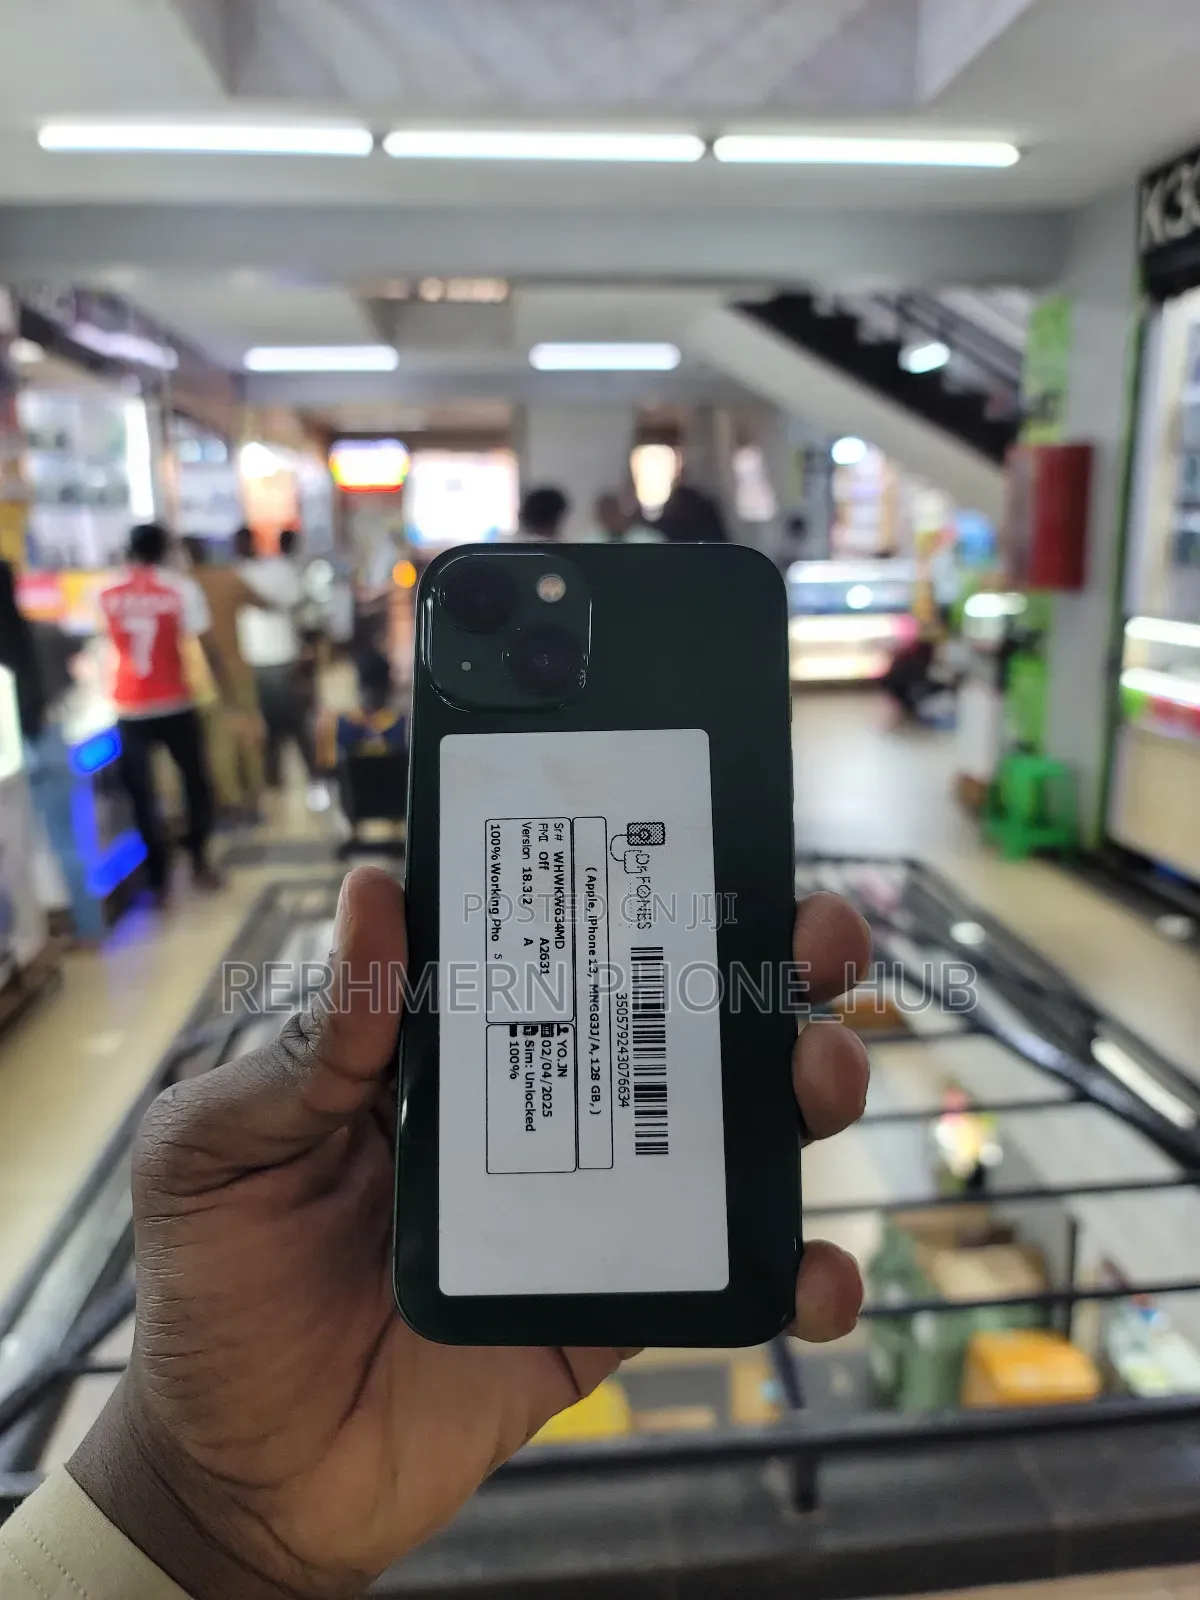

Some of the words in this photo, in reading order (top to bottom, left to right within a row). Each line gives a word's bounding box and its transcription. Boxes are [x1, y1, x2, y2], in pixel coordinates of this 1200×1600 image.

[123, 616, 159, 677] 7
[491, 824, 500, 860] 100%
[522, 822, 532, 859] Version
[539, 823, 548, 842] FMI
[554, 823, 563, 841] Sr#
[539, 851, 549, 870] Off
[489, 863, 501, 915] Working
[522, 867, 532, 905] 18.3.2
[554, 851, 564, 949] WHWKW634MD
[586, 875, 597, 912] Apple,
[523, 938, 533, 946] A
[588, 915, 599, 955] iPhone
[540, 937, 549, 976] A2631
[587, 959, 597, 978] 13,
[509, 1040, 519, 1079] 100%
[524, 1040, 535, 1068] Sim:
[557, 1039, 568, 1078] YO.JN
[616, 993, 630, 1107] 350579243076634
[541, 1040, 552, 1117] 02/04/2025
[591, 1059, 600, 1080] 128
[525, 1072, 536, 1132] Unlocked
[590, 1085, 600, 1106] GB,
